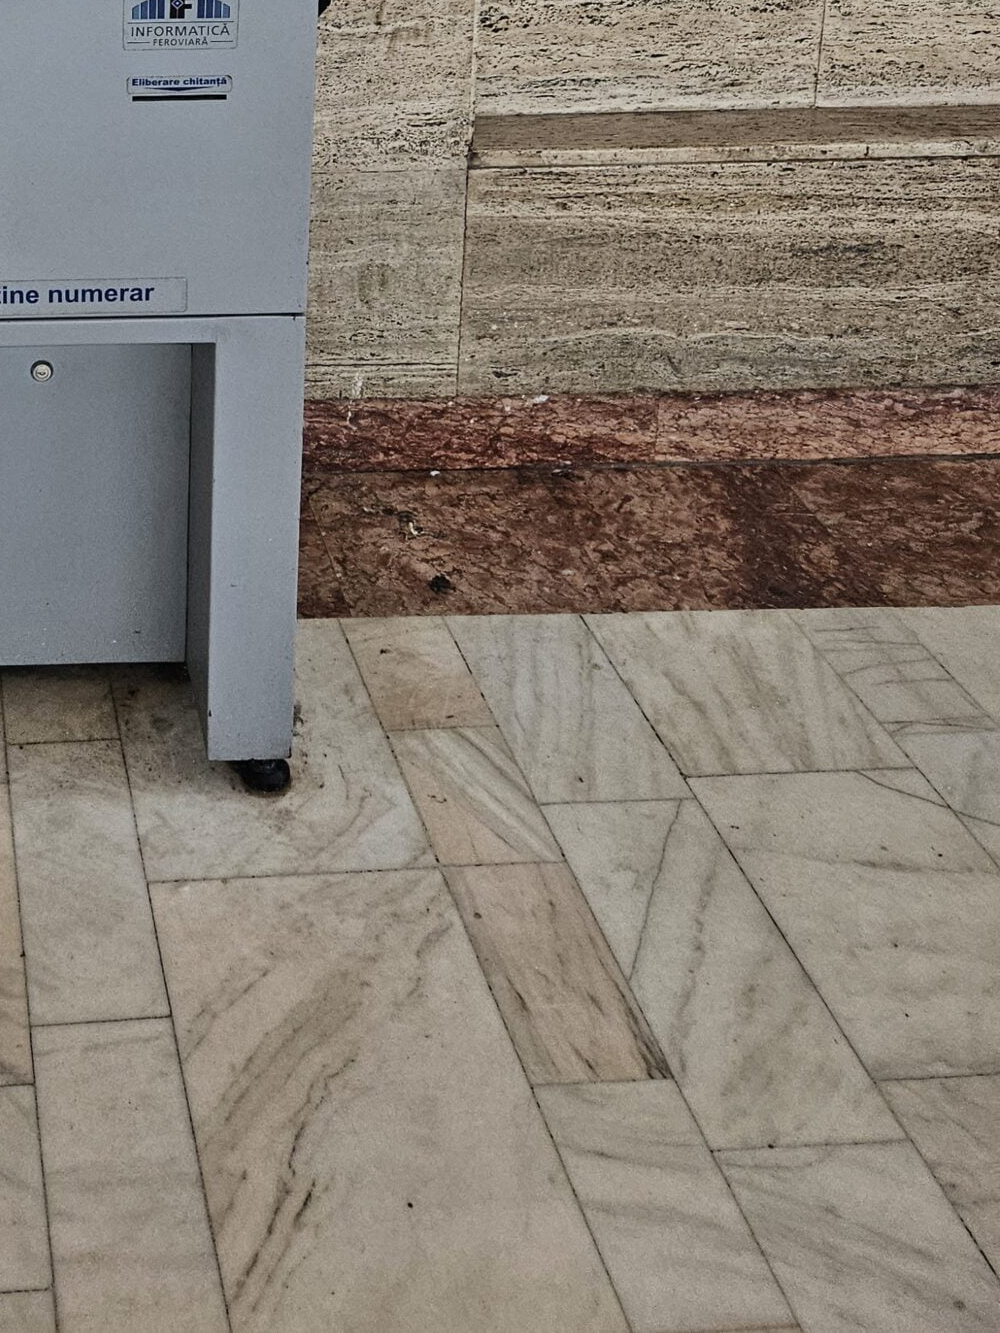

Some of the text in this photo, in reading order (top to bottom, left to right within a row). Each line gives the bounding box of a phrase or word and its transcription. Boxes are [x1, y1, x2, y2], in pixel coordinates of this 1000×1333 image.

[130, 22, 230, 37] INFORMATICĂ
[153, 36, 208, 46] FEROVIARĂ
[132, 77, 180, 86] Eliberare
[48, 286, 155, 303] numerar
